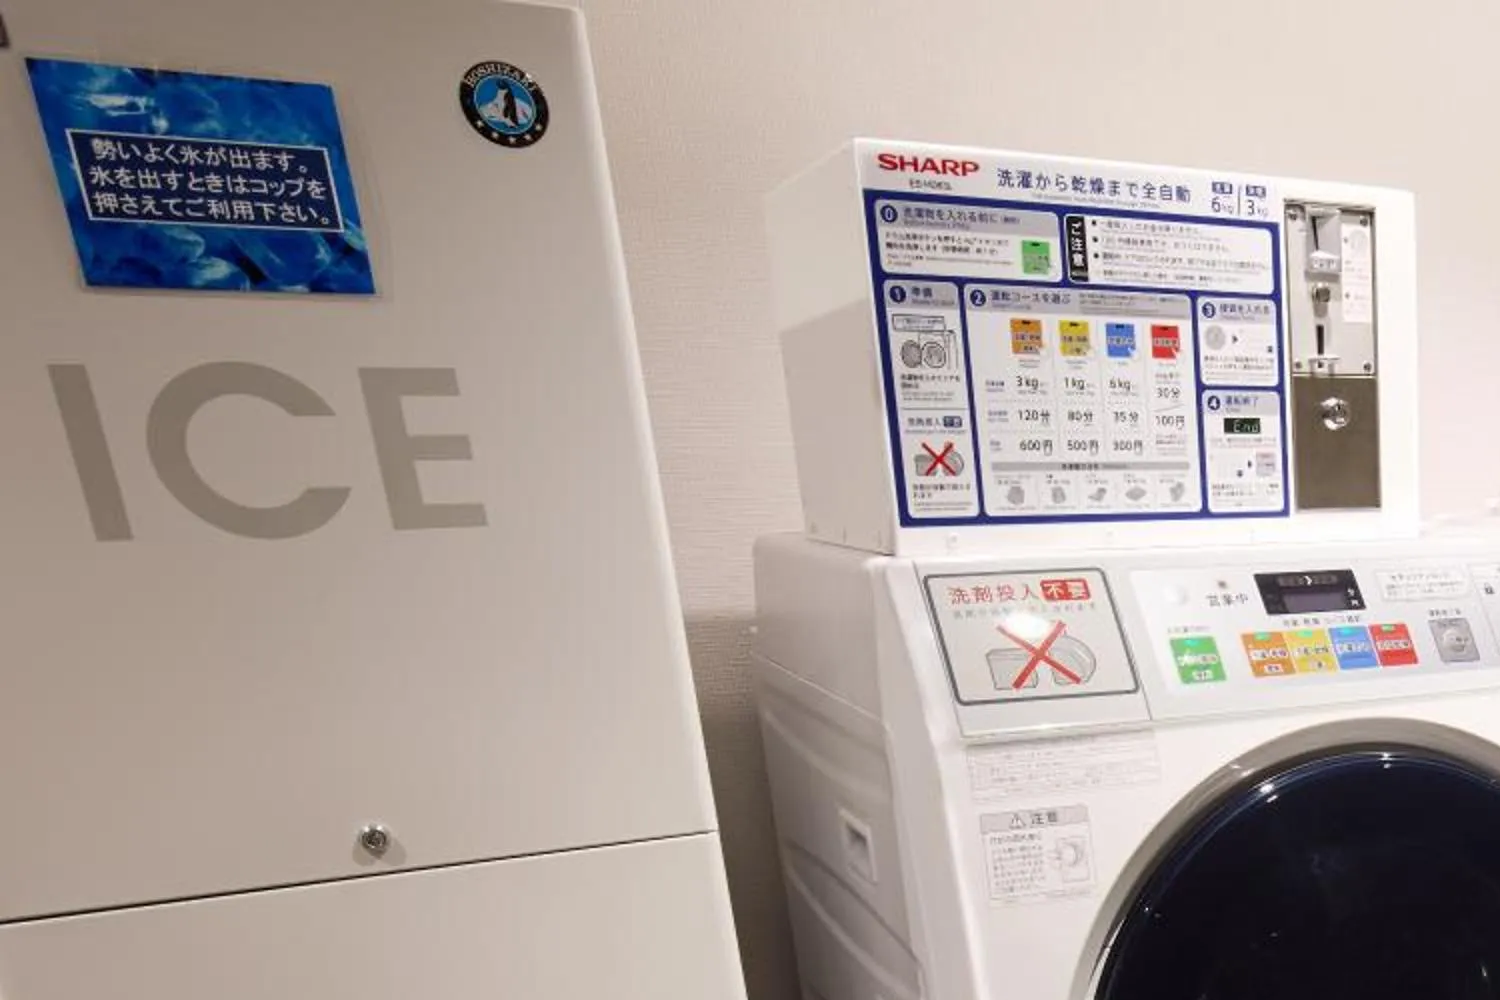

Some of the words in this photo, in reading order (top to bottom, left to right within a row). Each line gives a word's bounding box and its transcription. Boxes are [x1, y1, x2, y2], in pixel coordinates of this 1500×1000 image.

[92, 138, 307, 172] 勢いよく氷が出ます。
[877, 153, 979, 177] SHARP
[89, 167, 326, 199] 氷を出すときはコップを
[997, 168, 1191, 203] 洗濯から乾燥まで全自動
[93, 192, 328, 224] 押さえてご利用下さい。
[47, 361, 489, 541] ICE
